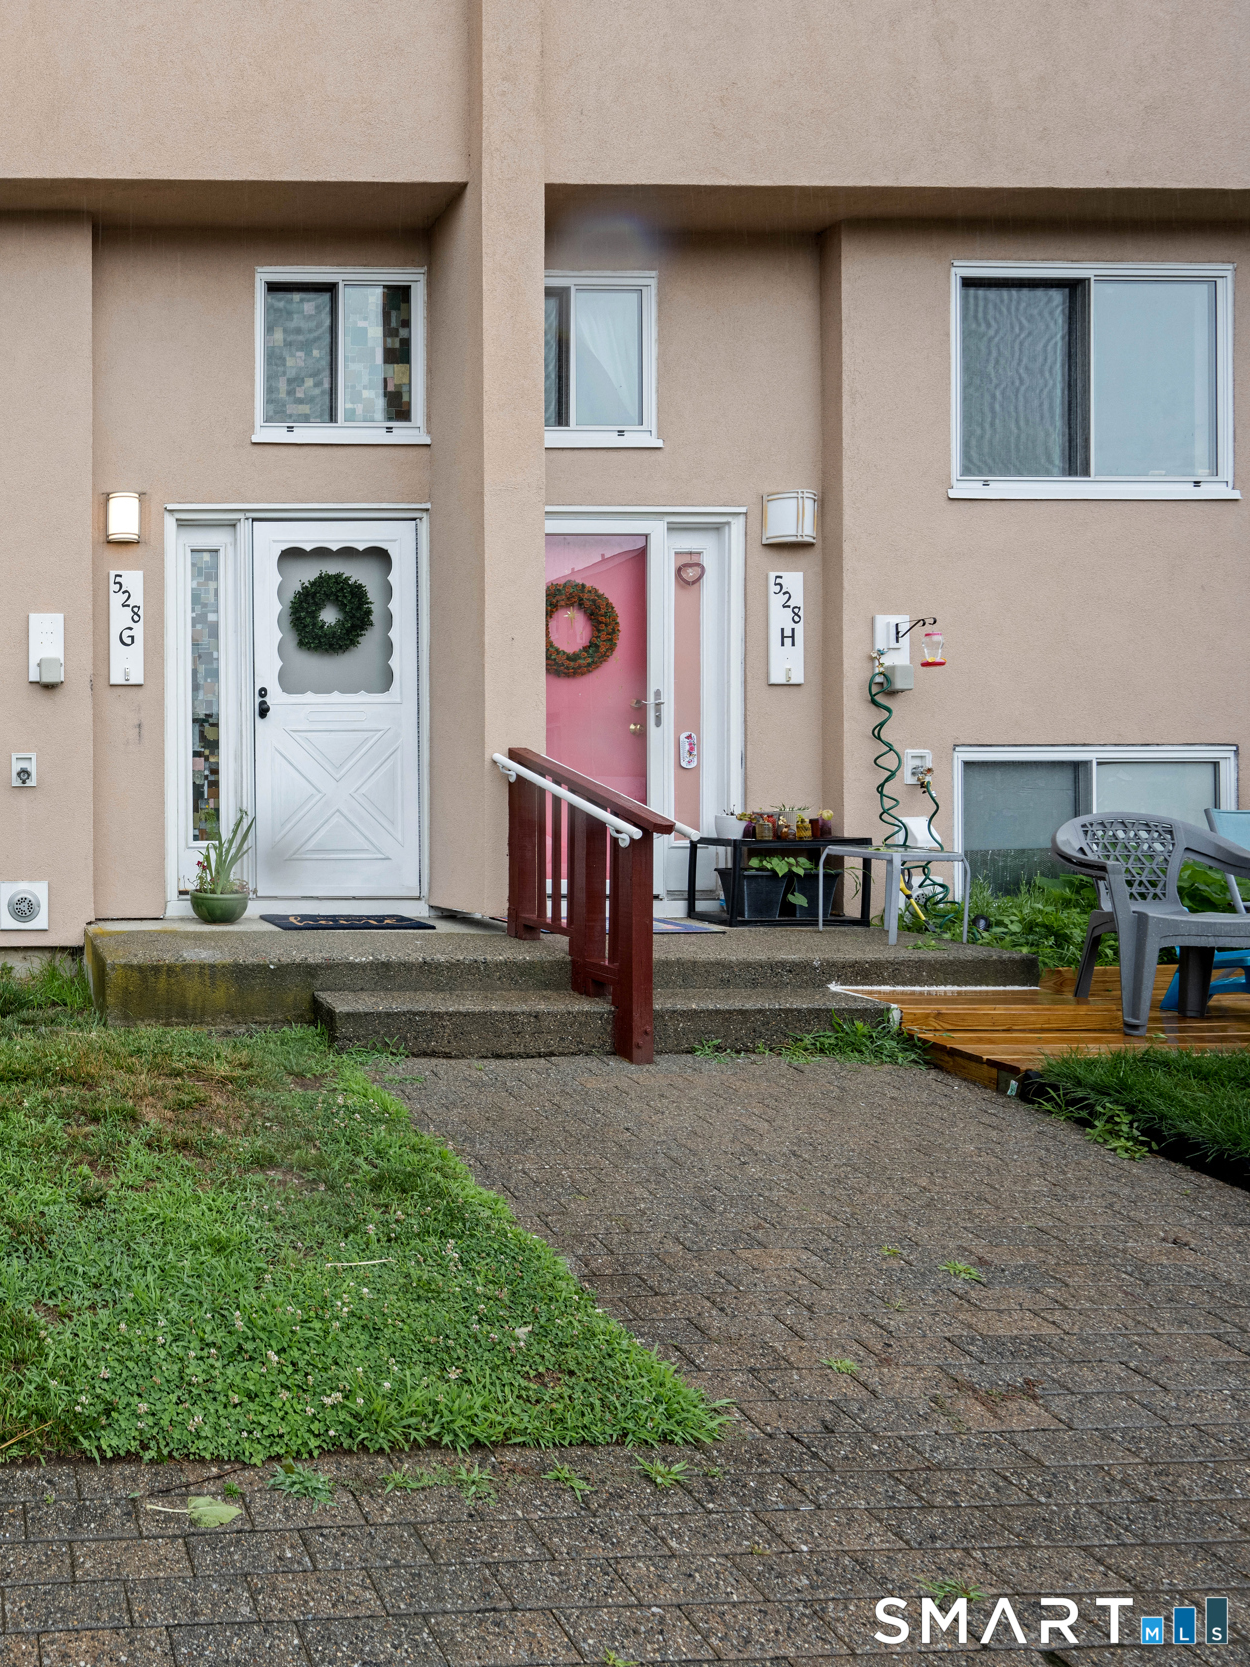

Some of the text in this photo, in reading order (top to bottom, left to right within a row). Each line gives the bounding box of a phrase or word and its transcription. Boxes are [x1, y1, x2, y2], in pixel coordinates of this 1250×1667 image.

[113, 574, 141, 623] 528
[773, 575, 802, 624] 528
[119, 626, 135, 646] G
[780, 627, 796, 647] H
